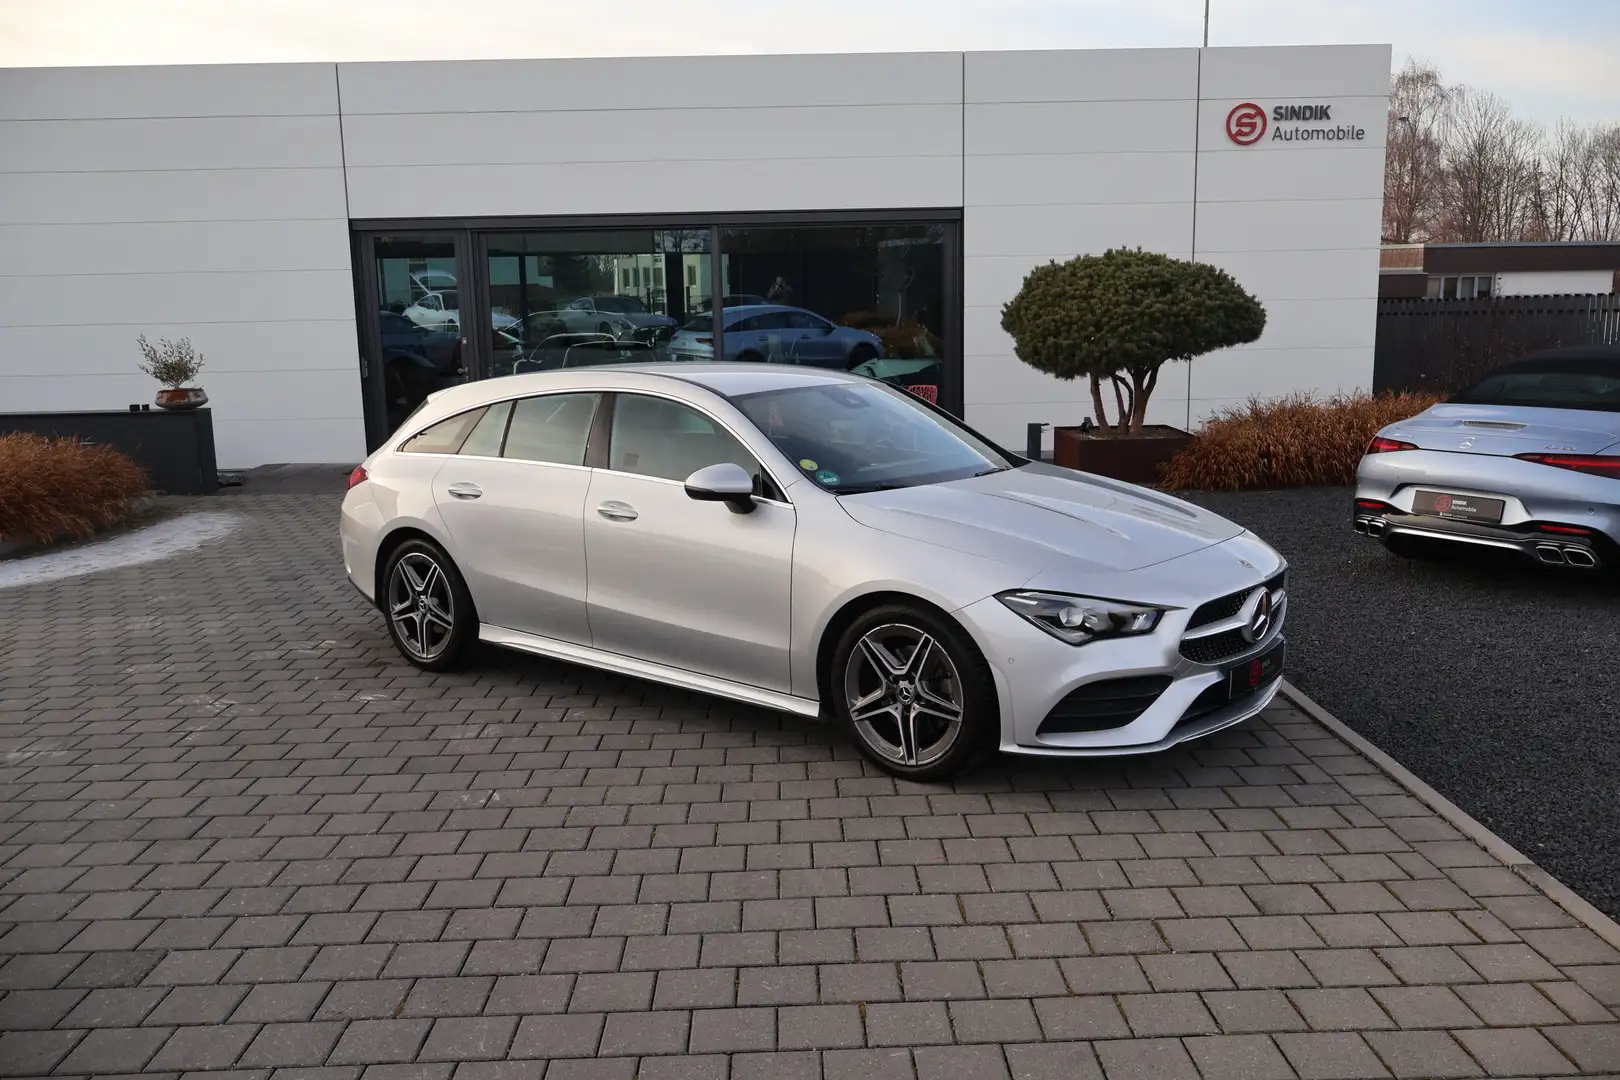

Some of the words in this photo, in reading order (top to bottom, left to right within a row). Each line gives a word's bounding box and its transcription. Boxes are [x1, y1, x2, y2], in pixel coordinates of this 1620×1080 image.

[1272, 105, 1331, 121] SINDIK
[1272, 125, 1365, 141] Automobile
[1451, 504, 1477, 513] Automobile
